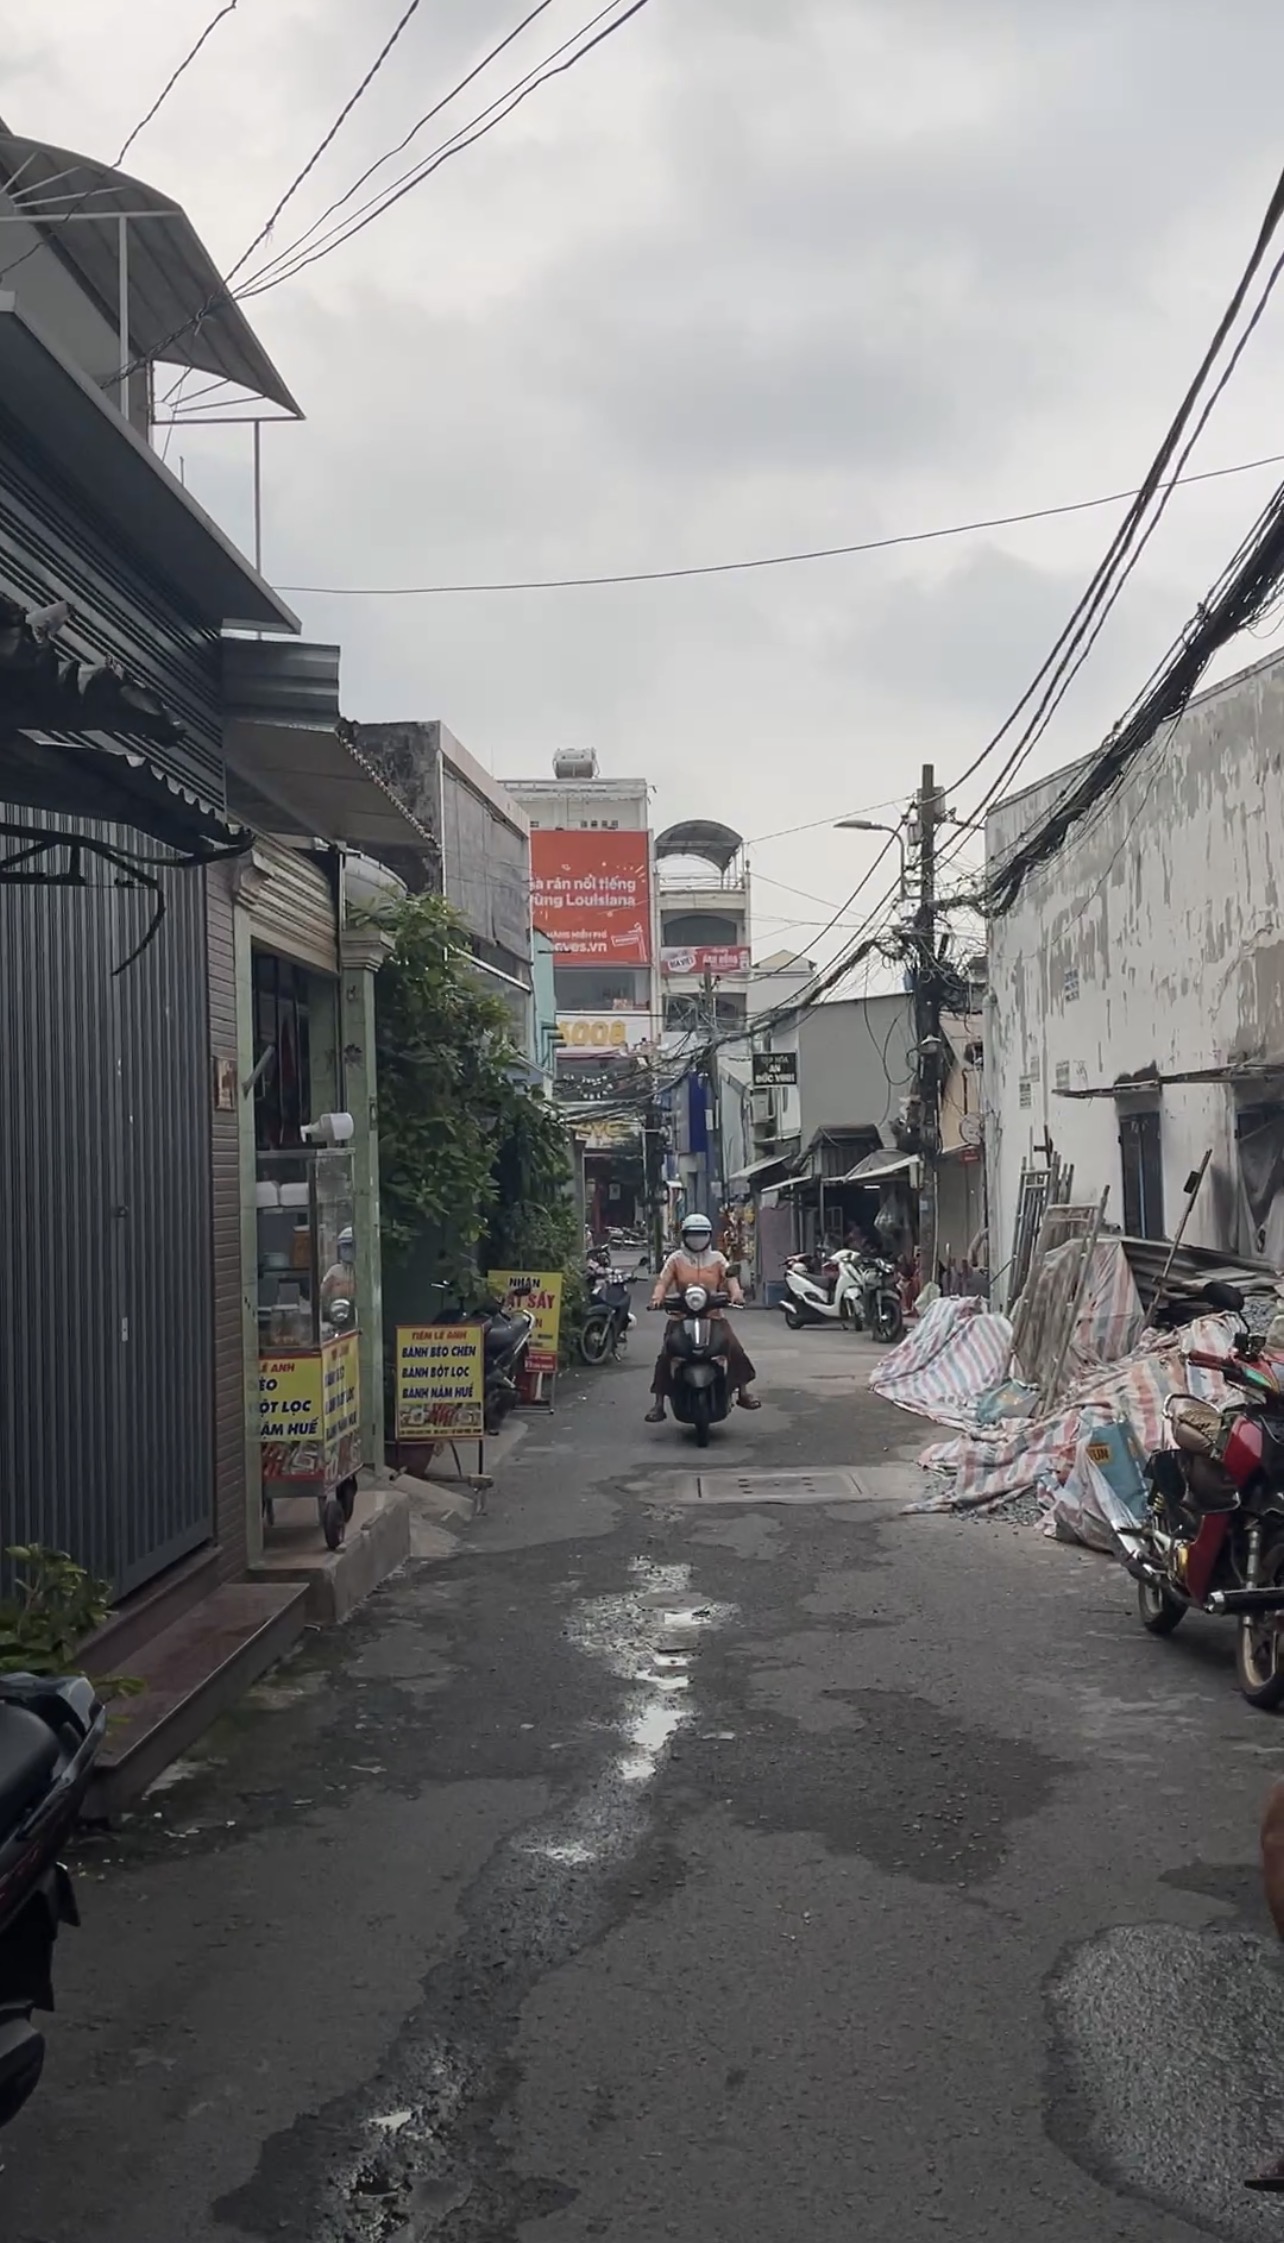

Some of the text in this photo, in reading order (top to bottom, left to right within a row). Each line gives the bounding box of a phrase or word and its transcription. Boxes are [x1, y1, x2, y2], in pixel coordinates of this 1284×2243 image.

[546, 877, 572, 890] rán
[573, 873, 597, 890] nổi
[598, 875, 637, 893] tiếng
[532, 892, 637, 908] ùng Louisiana
[527, 1289, 556, 1309] SẤY
[271, 1363, 295, 1373] ANH
[259, 1377, 278, 1392] ÈO
[259, 1399, 279, 1418] ỘT
[281, 1401, 311, 1416] LỌC
[260, 1421, 284, 1440] ẬM
[287, 1417, 319, 1436] HUẾ
